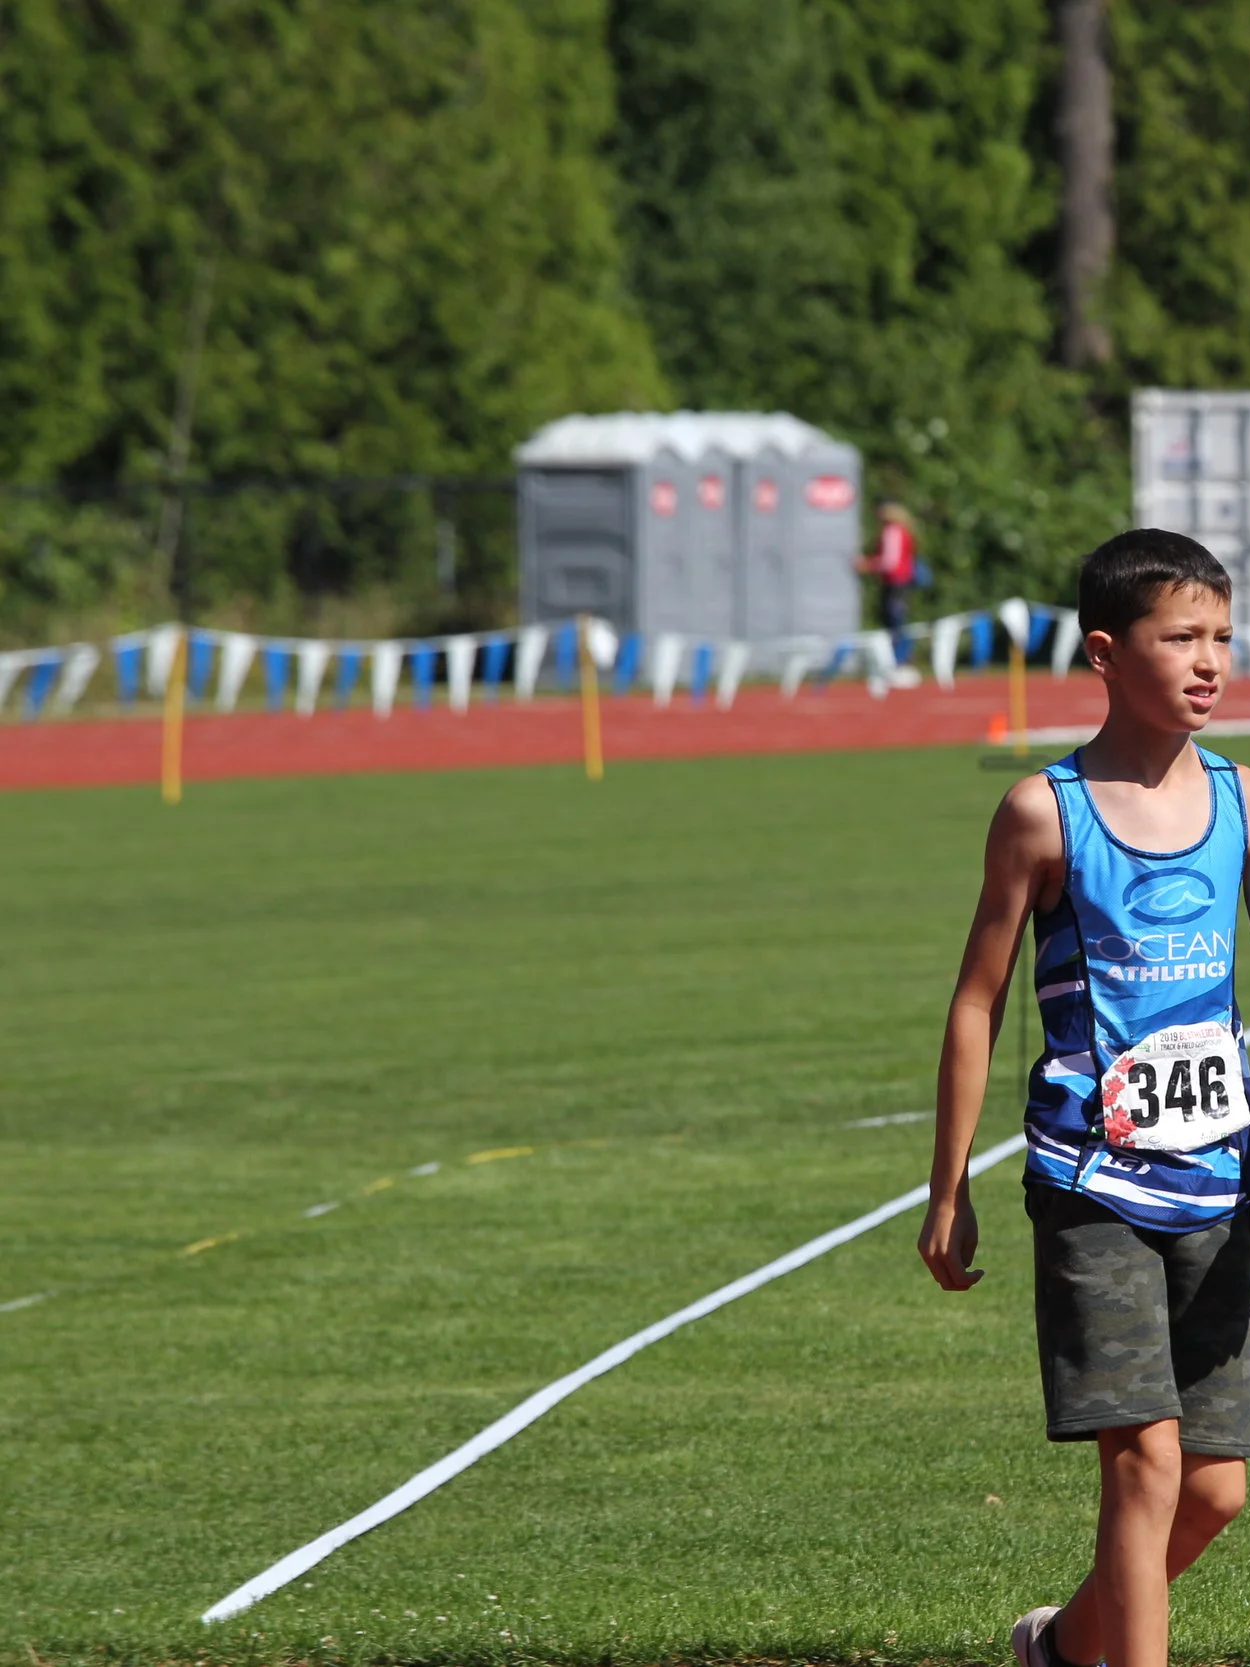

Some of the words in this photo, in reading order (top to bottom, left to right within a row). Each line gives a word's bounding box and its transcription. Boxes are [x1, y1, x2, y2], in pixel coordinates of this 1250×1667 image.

[1096, 928, 1231, 962] OCEAN
[1106, 961, 1226, 982] ATHLETICS
[1160, 1032, 1178, 1042] 2019
[1160, 1043, 1176, 1051] TRACK
[1182, 1041, 1195, 1050] FIELD
[1128, 1056, 1231, 1129] 346
